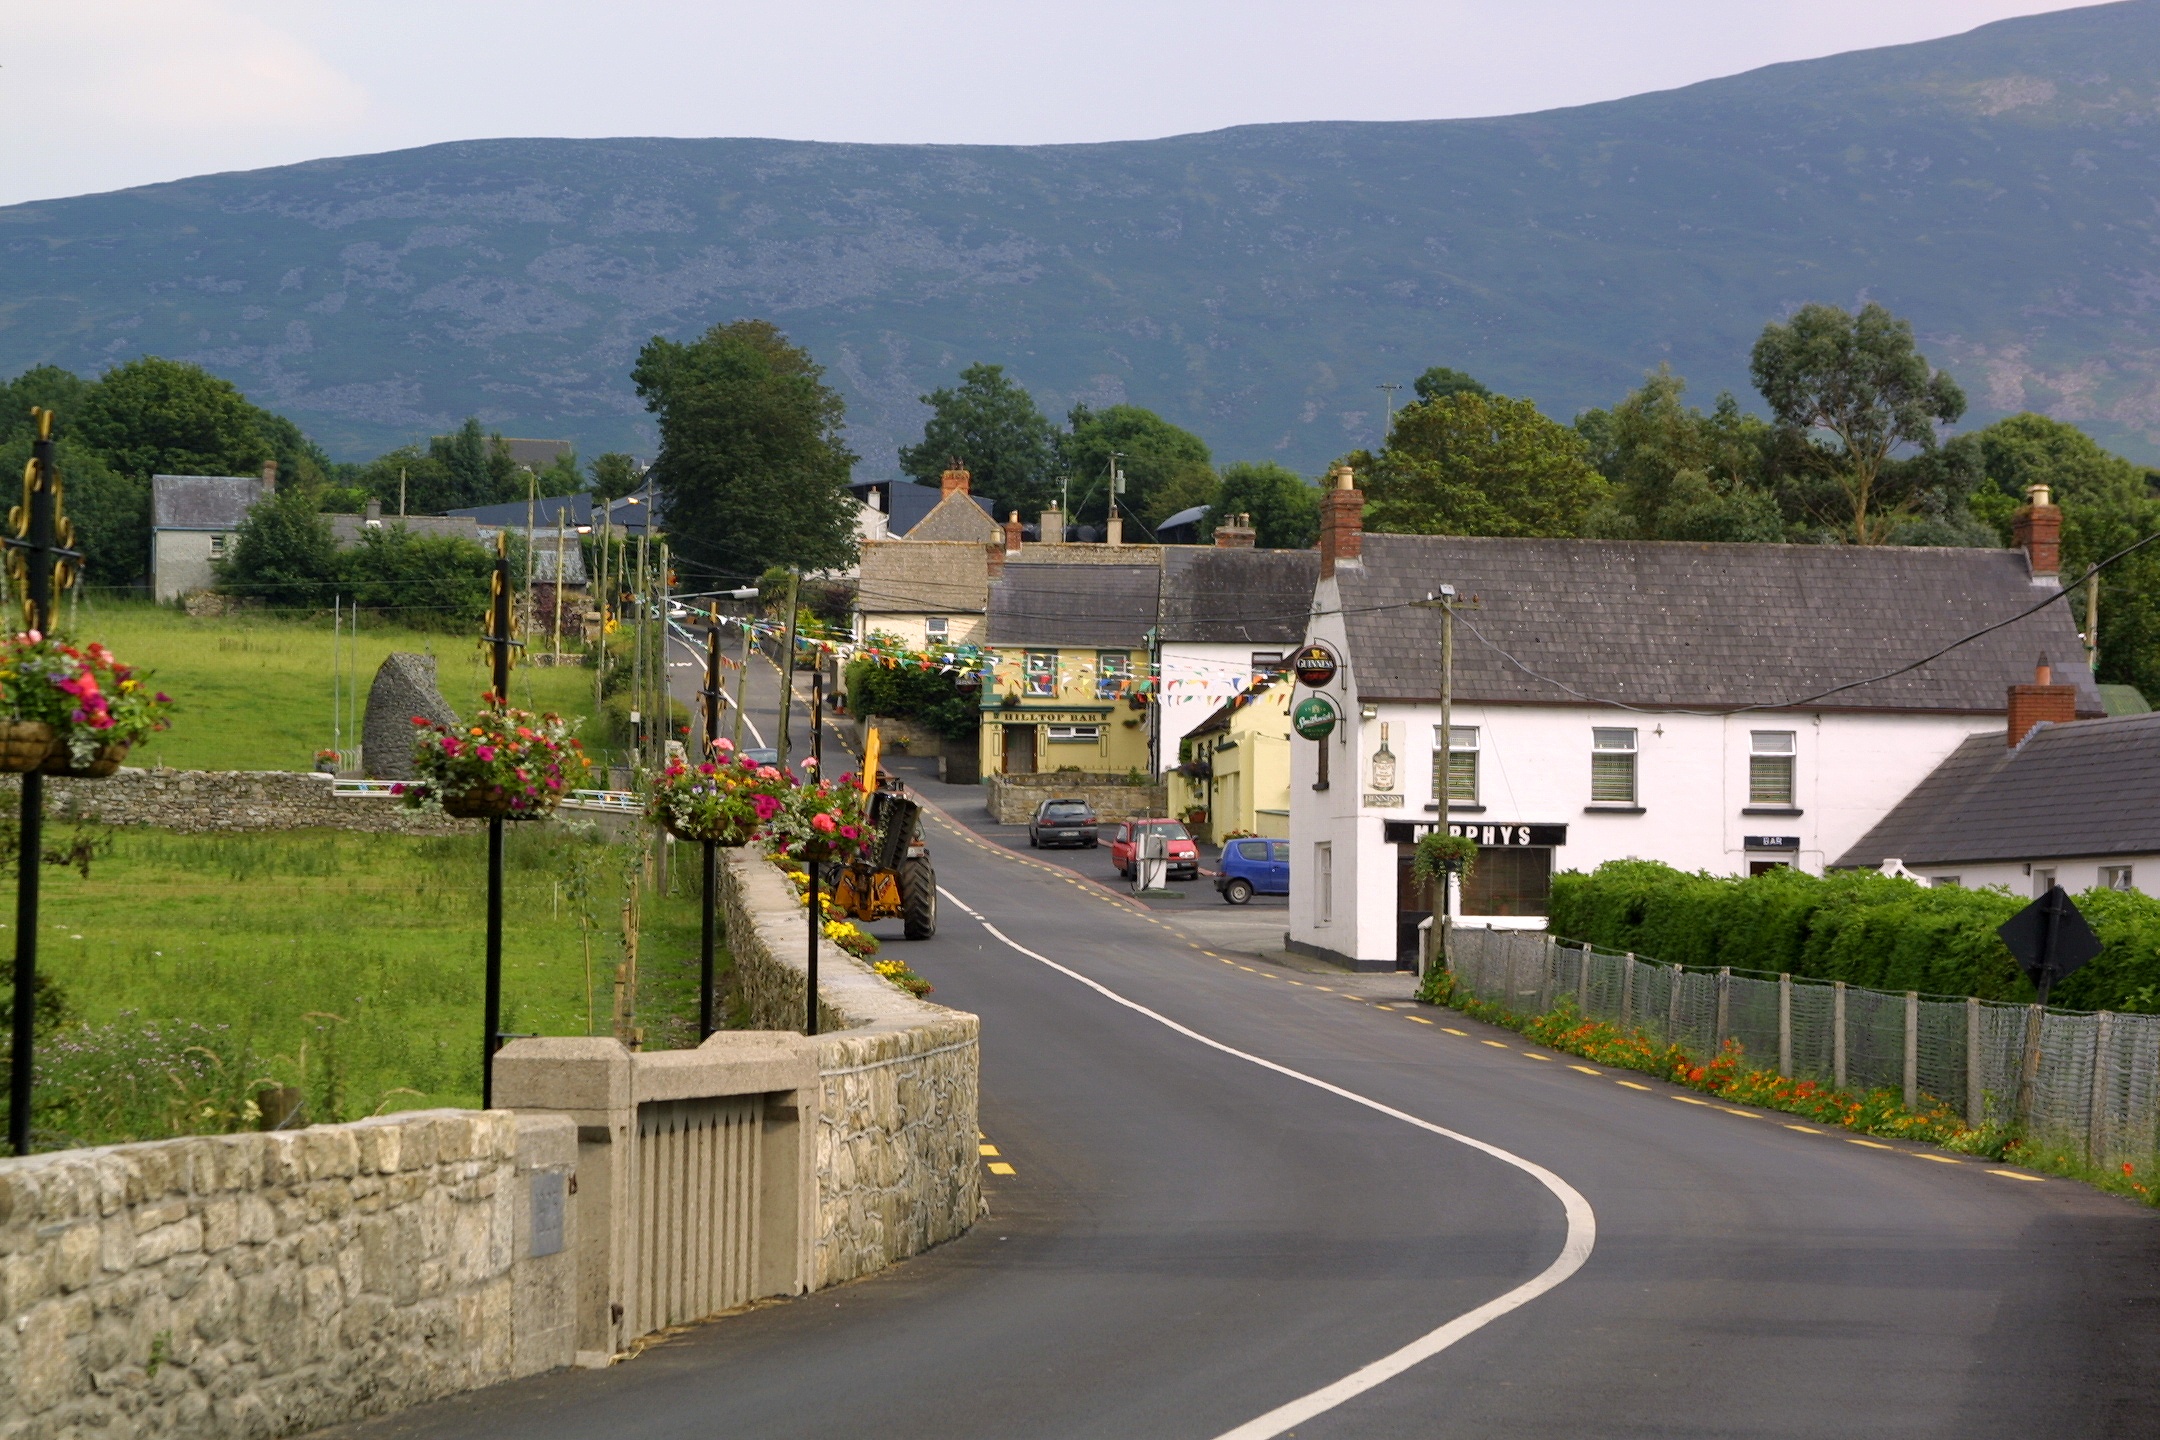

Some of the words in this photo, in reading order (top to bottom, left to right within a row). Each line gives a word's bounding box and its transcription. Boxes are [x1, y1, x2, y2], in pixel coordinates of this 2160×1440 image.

[1297, 659, 1334, 669] GUINNESS
[1004, 713, 1065, 721] HILLTOP
[1070, 713, 1097, 721] BAR
[1763, 837, 1782, 845] BAR
